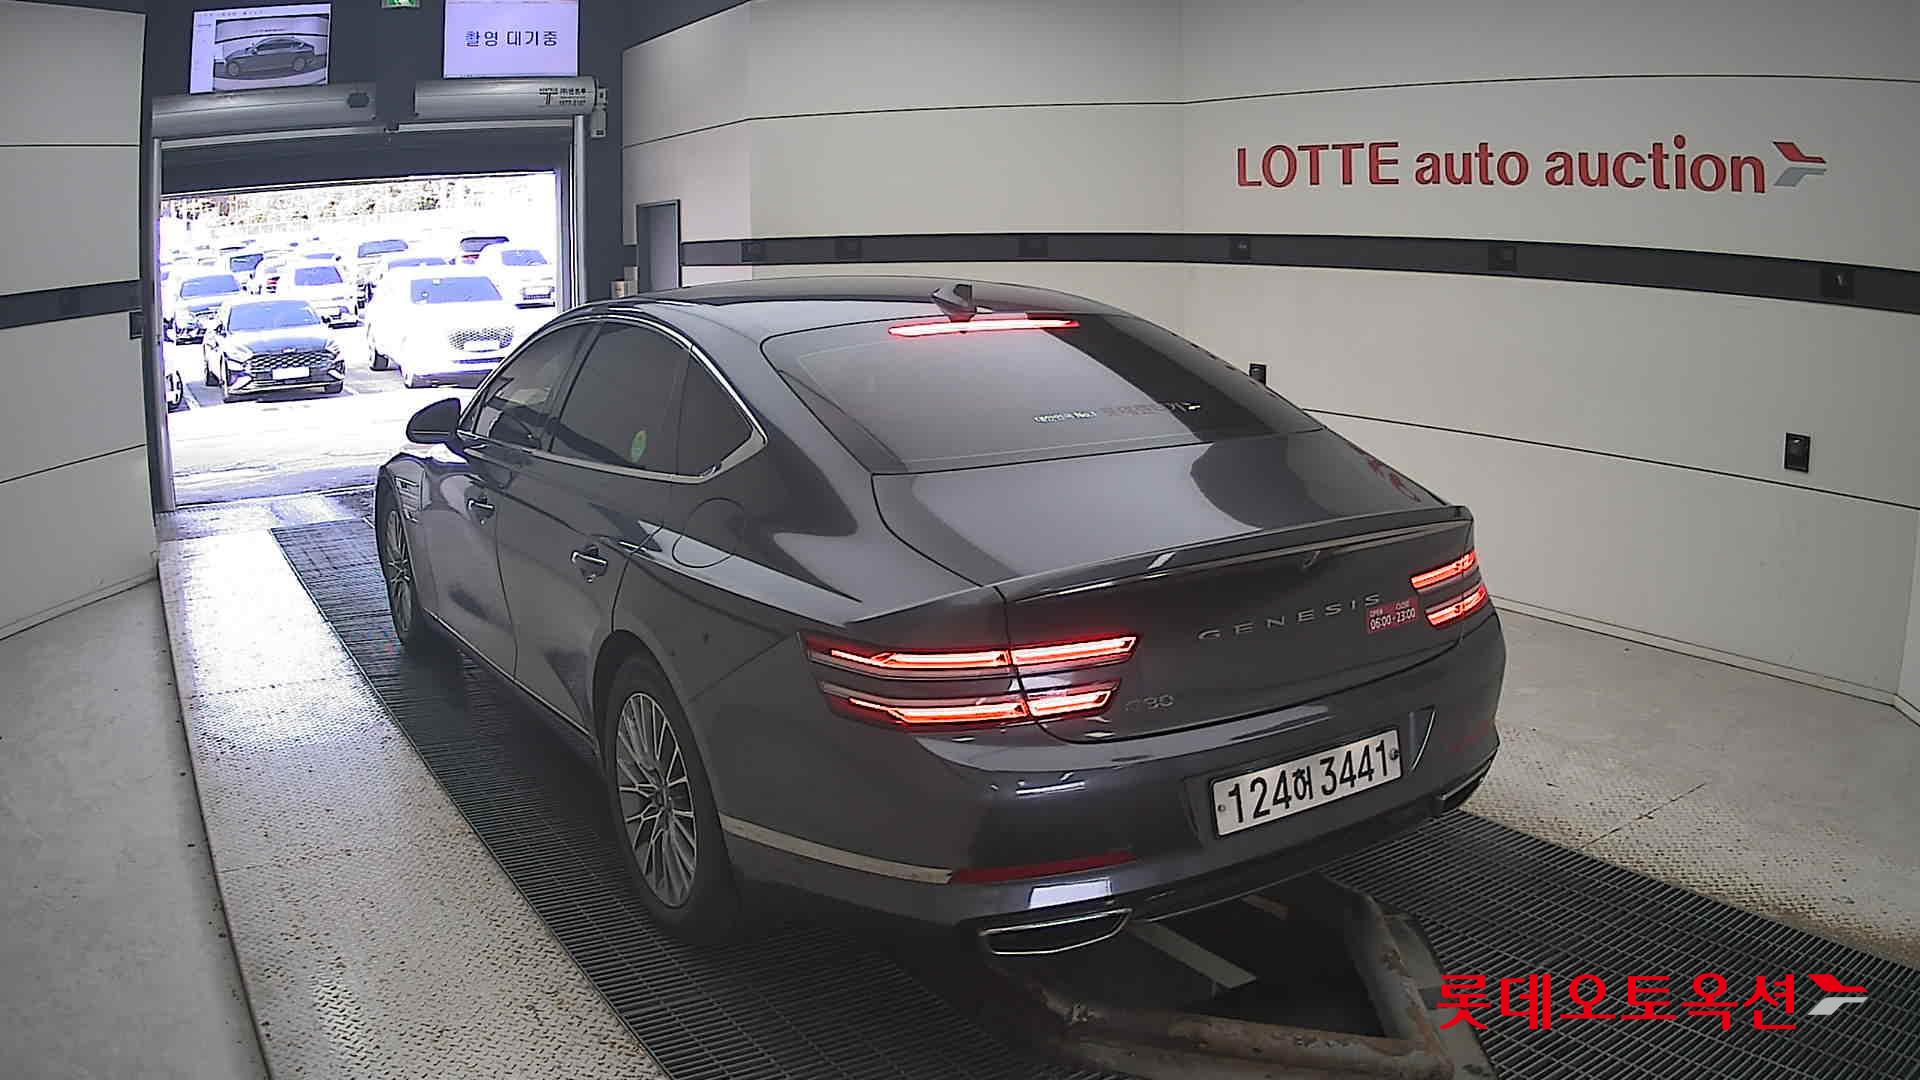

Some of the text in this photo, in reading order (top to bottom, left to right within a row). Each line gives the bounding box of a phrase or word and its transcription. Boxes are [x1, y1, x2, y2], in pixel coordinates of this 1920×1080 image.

[465, 30, 557, 47] 촬영 대기중
[1237, 134, 1767, 194] LOTTE auto auction
[1197, 594, 1380, 640] GENESIS
[1228, 739, 1388, 823] 124허 3441
